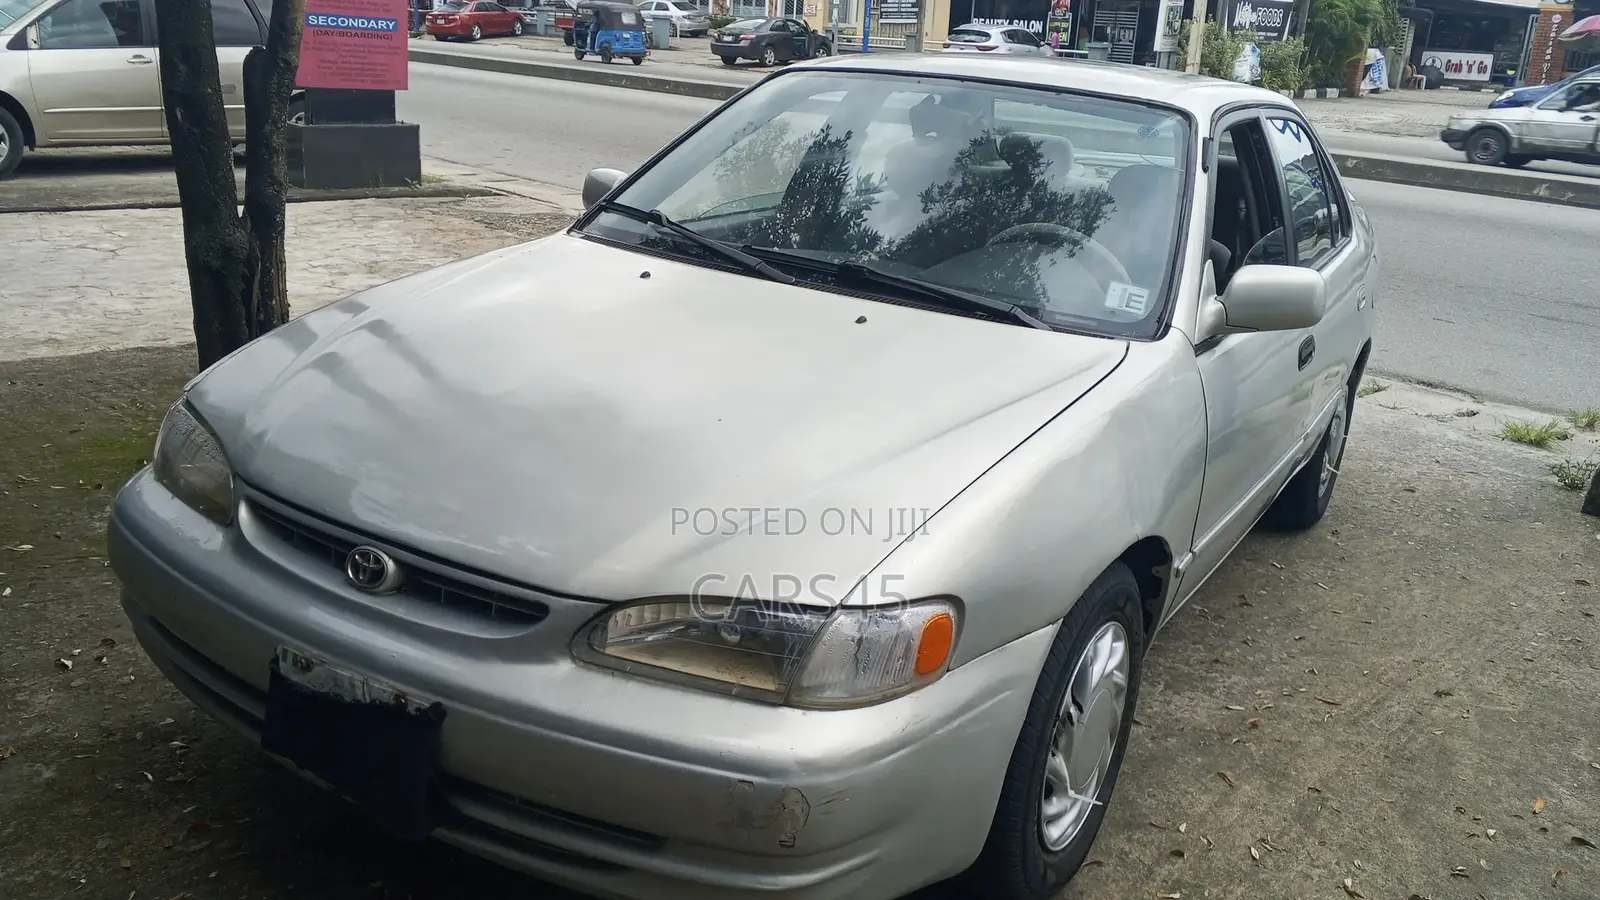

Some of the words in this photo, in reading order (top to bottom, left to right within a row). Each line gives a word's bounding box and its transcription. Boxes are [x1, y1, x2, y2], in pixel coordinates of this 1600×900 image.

[308, 15, 396, 30] SECONDARY
[1255, 7, 1284, 27] FOODS
[1013, 19, 1043, 34] SALON
[312, 29, 393, 41] (DAY/BOARDING)
[1445, 58, 1463, 74] Grab
[1477, 60, 1488, 75] Go
